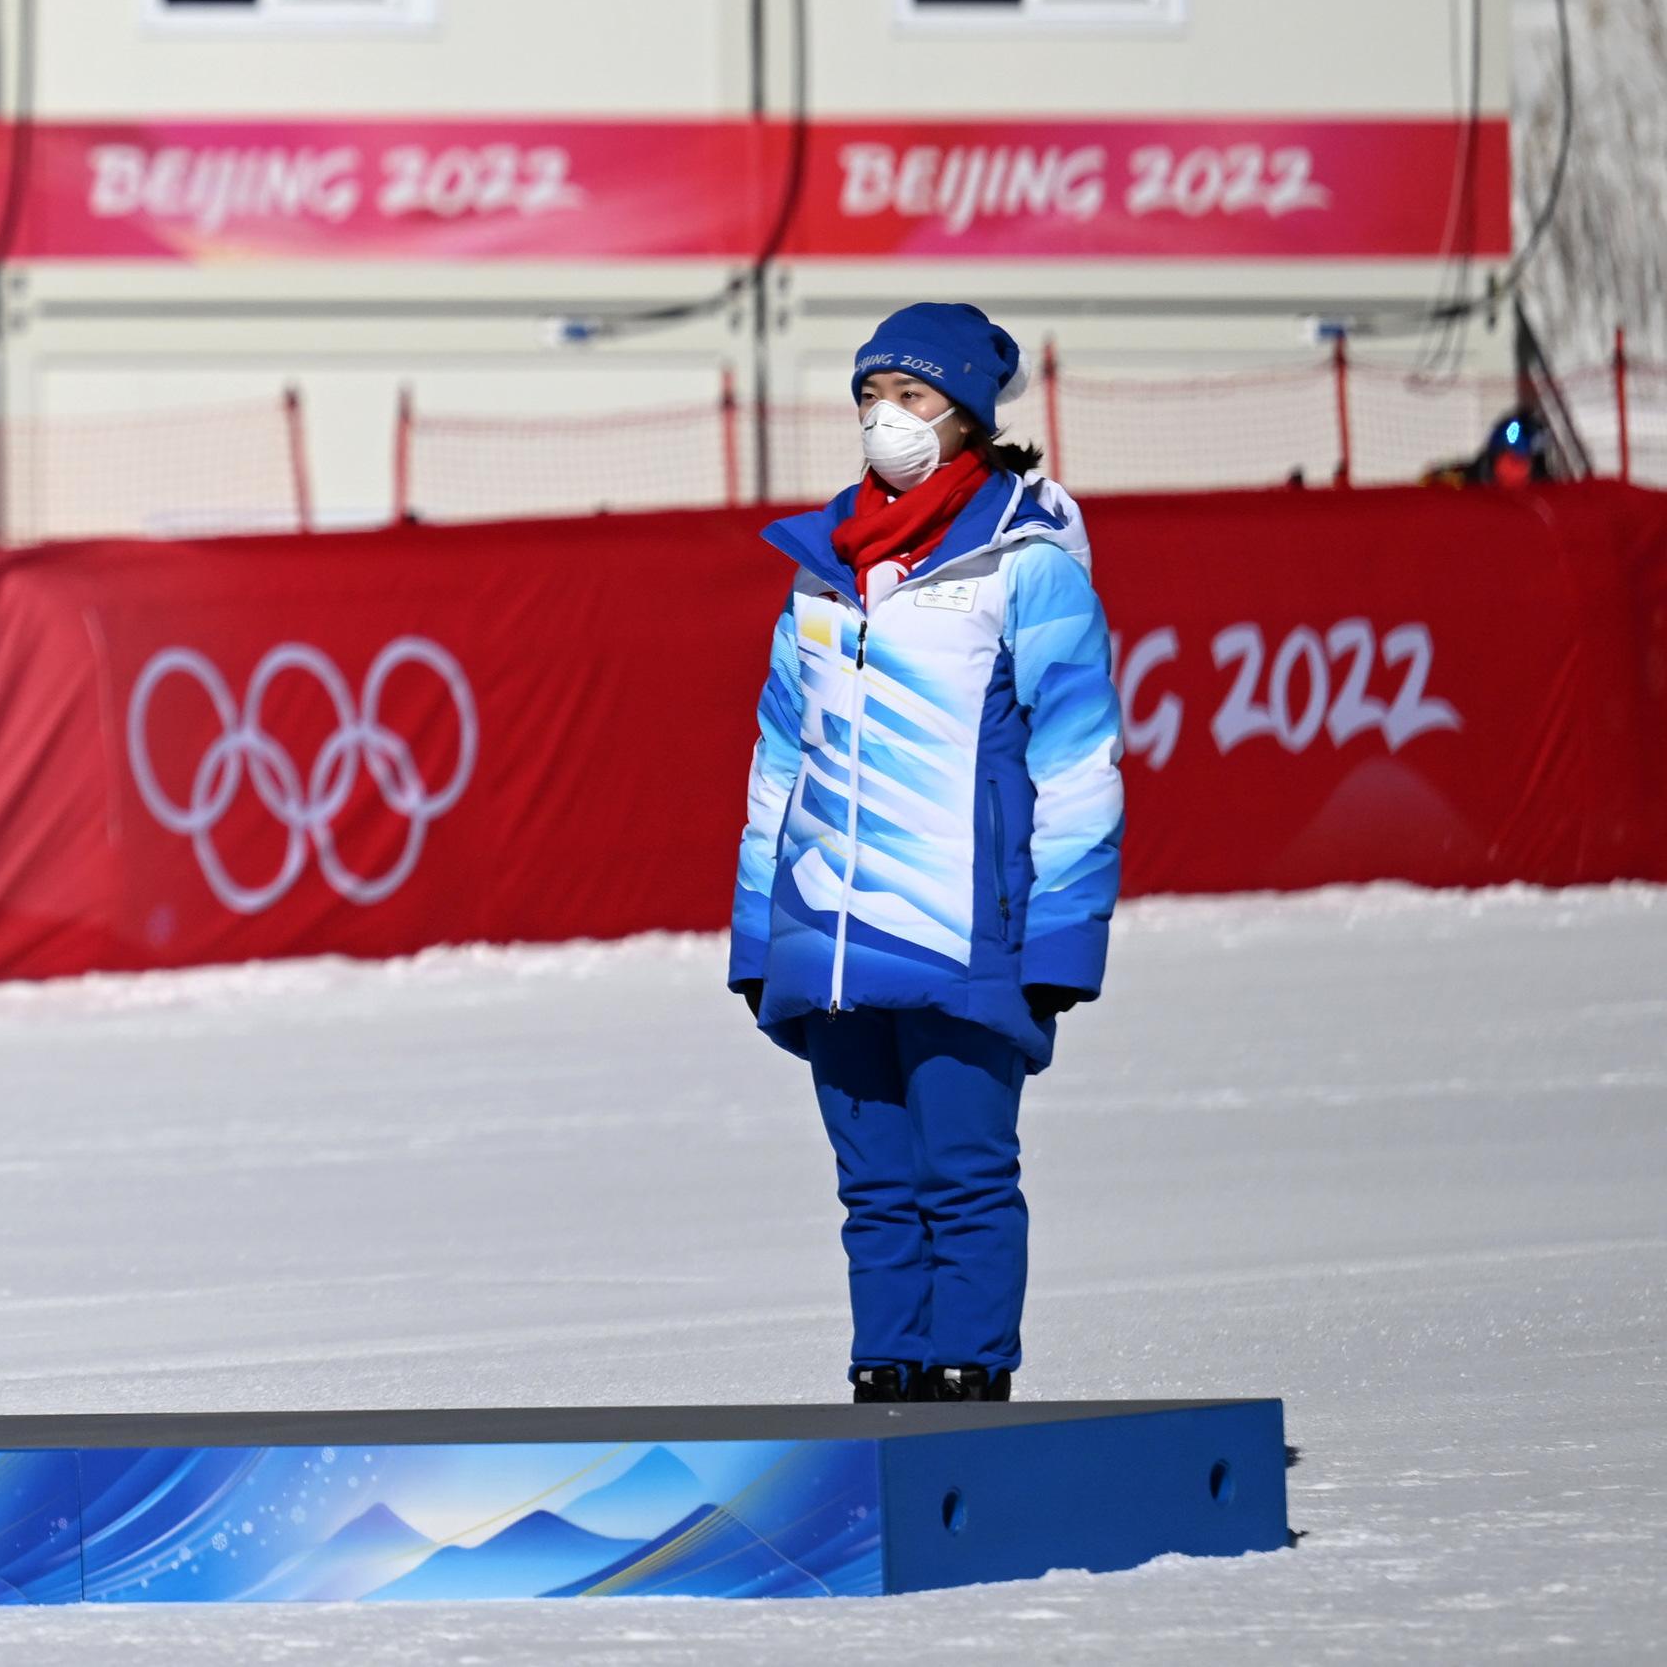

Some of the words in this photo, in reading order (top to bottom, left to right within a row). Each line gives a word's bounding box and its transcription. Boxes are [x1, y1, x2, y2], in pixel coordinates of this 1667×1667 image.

[87, 142, 360, 230] BEIJING
[376, 143, 581, 215] 2022
[838, 142, 1105, 236] BEIJING
[1125, 145, 1330, 215] 2022
[900, 355, 944, 379] 2022
[1210, 615, 1465, 756] 2022
